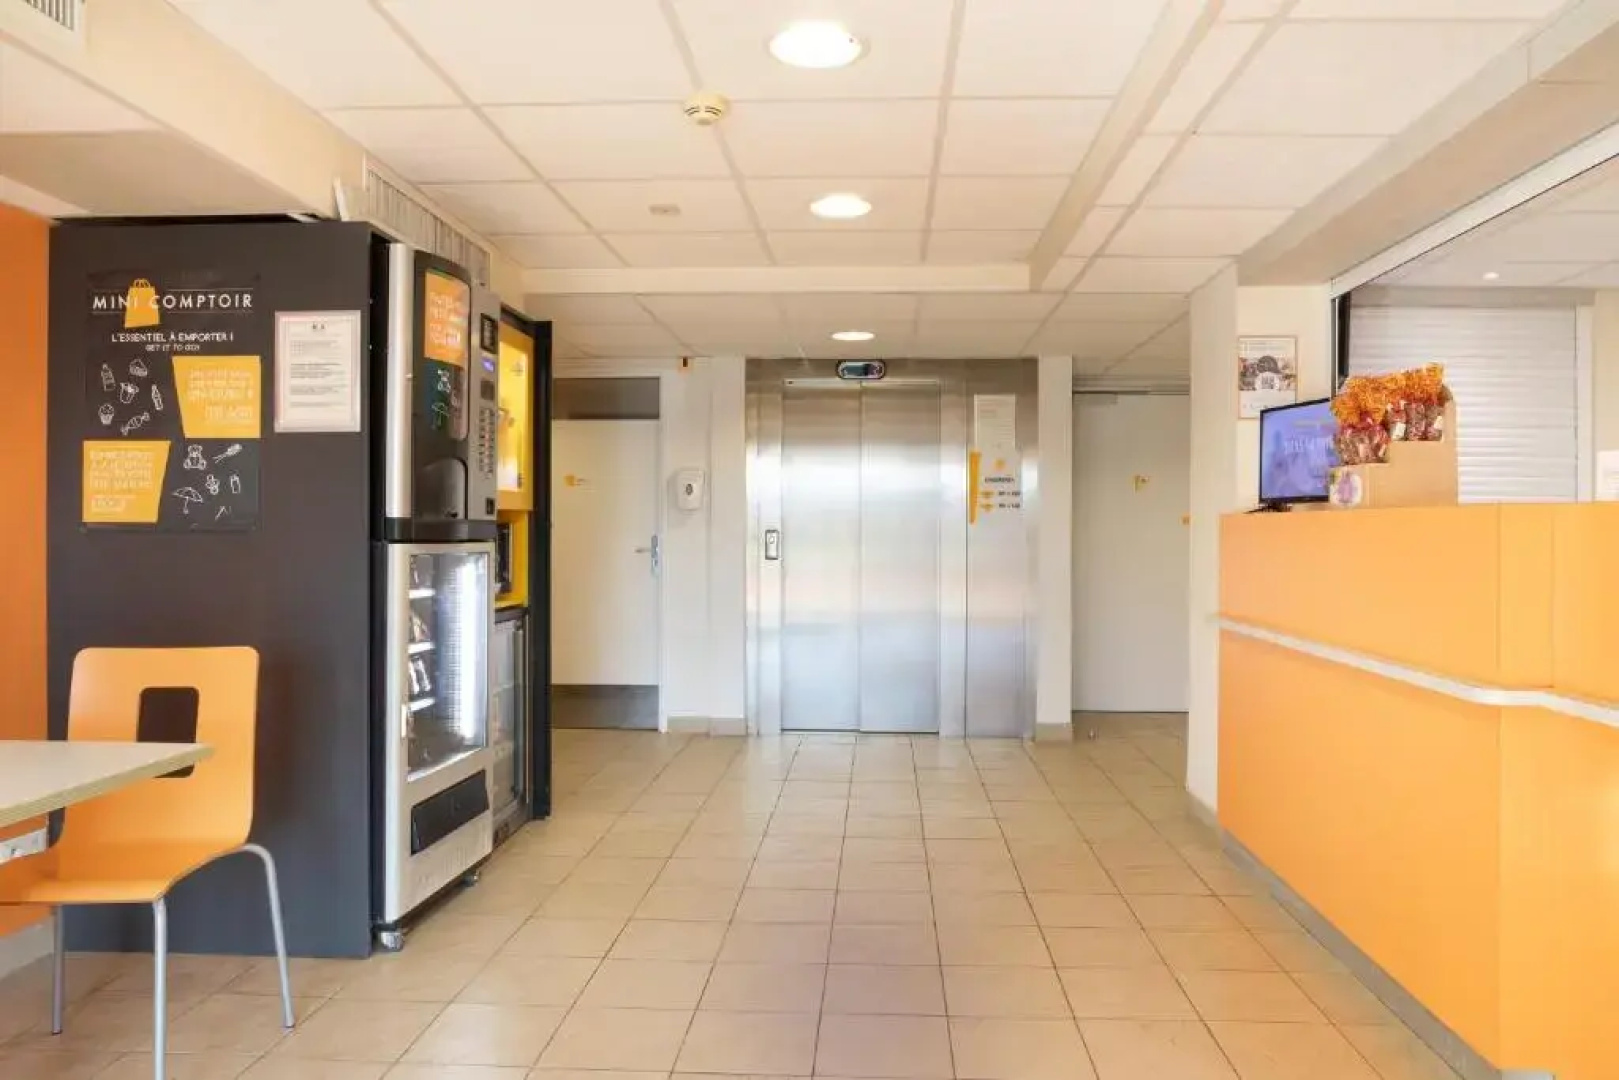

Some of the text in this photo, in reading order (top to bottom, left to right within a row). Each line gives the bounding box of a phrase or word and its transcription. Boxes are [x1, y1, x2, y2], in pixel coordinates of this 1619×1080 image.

[93, 293, 253, 309] MINI COMPTOIR
[111, 332, 167, 342] L'ESSENTIEL
[178, 332, 227, 341] EMPORTER
